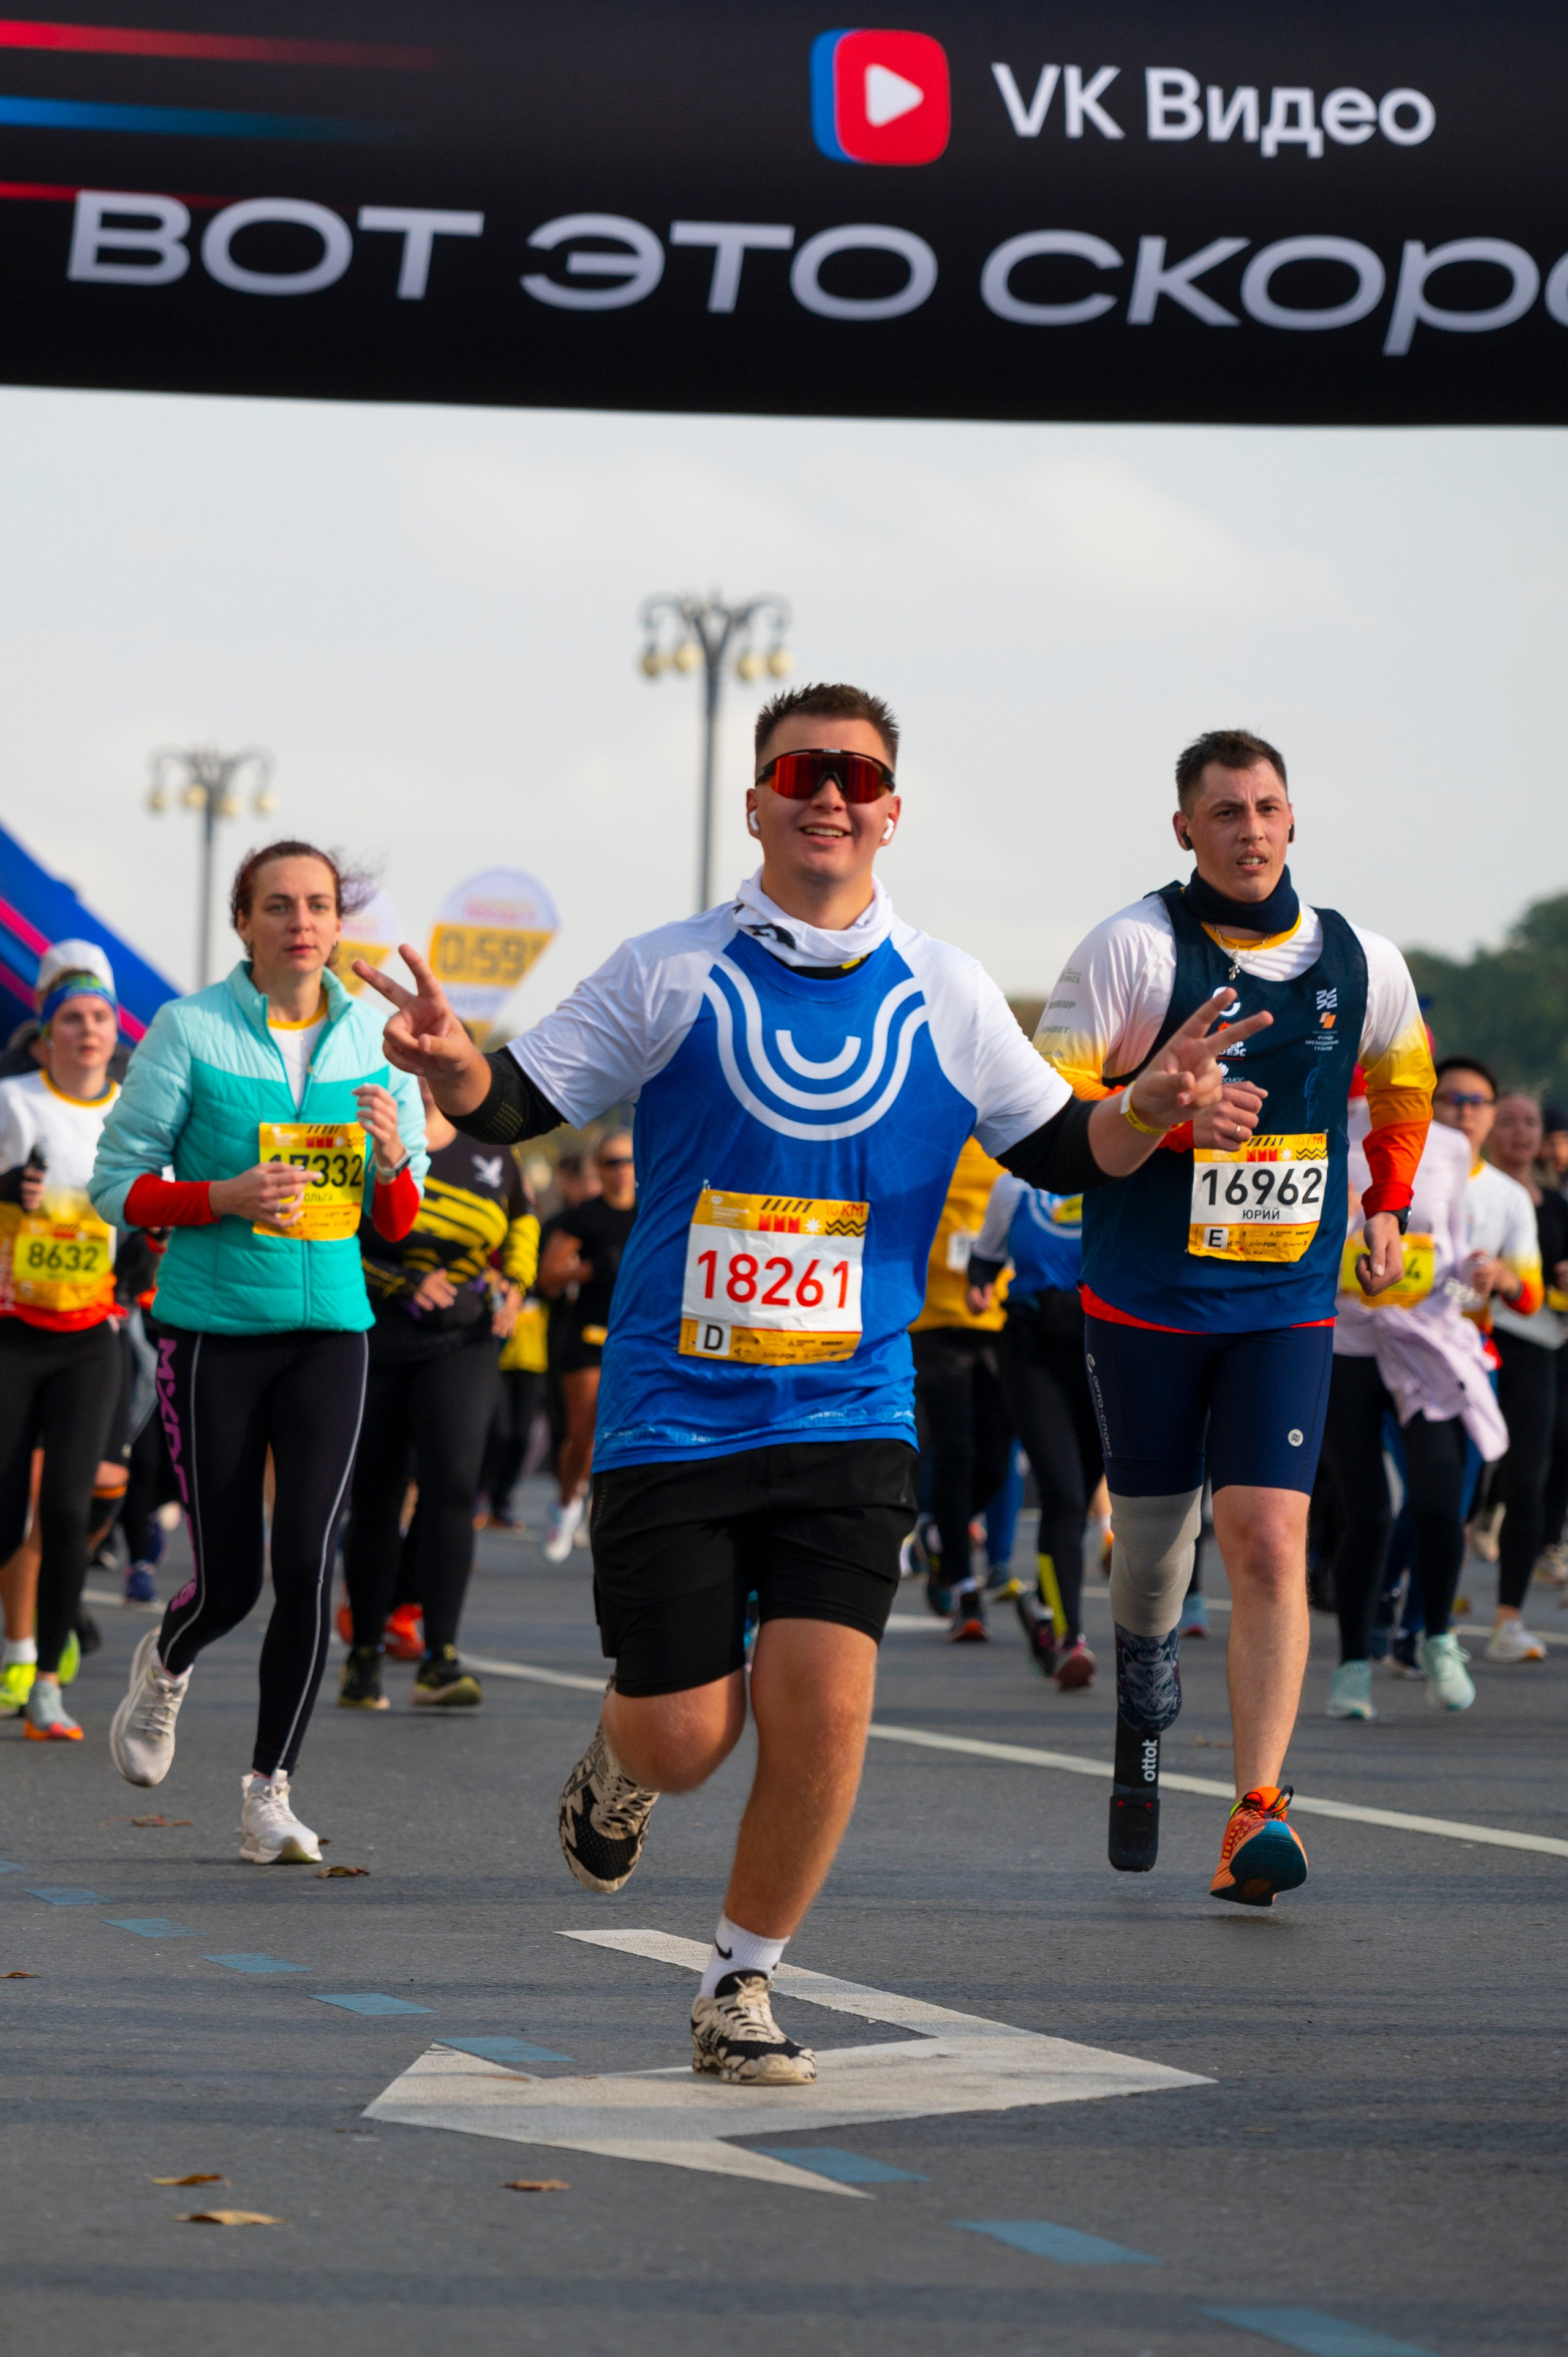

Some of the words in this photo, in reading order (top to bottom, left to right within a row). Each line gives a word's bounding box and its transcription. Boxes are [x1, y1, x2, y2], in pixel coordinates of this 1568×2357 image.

[992, 62, 1125, 140] VK
[1145, 66, 1436, 159] Видео
[980, 229, 1568, 356] скор
[270, 1154, 363, 1188] 7332
[1202, 1167, 1324, 1207] 16962
[304, 1193, 333, 1203] ОЛЬГА
[1242, 1207, 1280, 1220] ЮРИЙ
[28, 1242, 99, 1272] 8632
[697, 1250, 849, 1309] 18261
[703, 1324, 724, 1351] D
